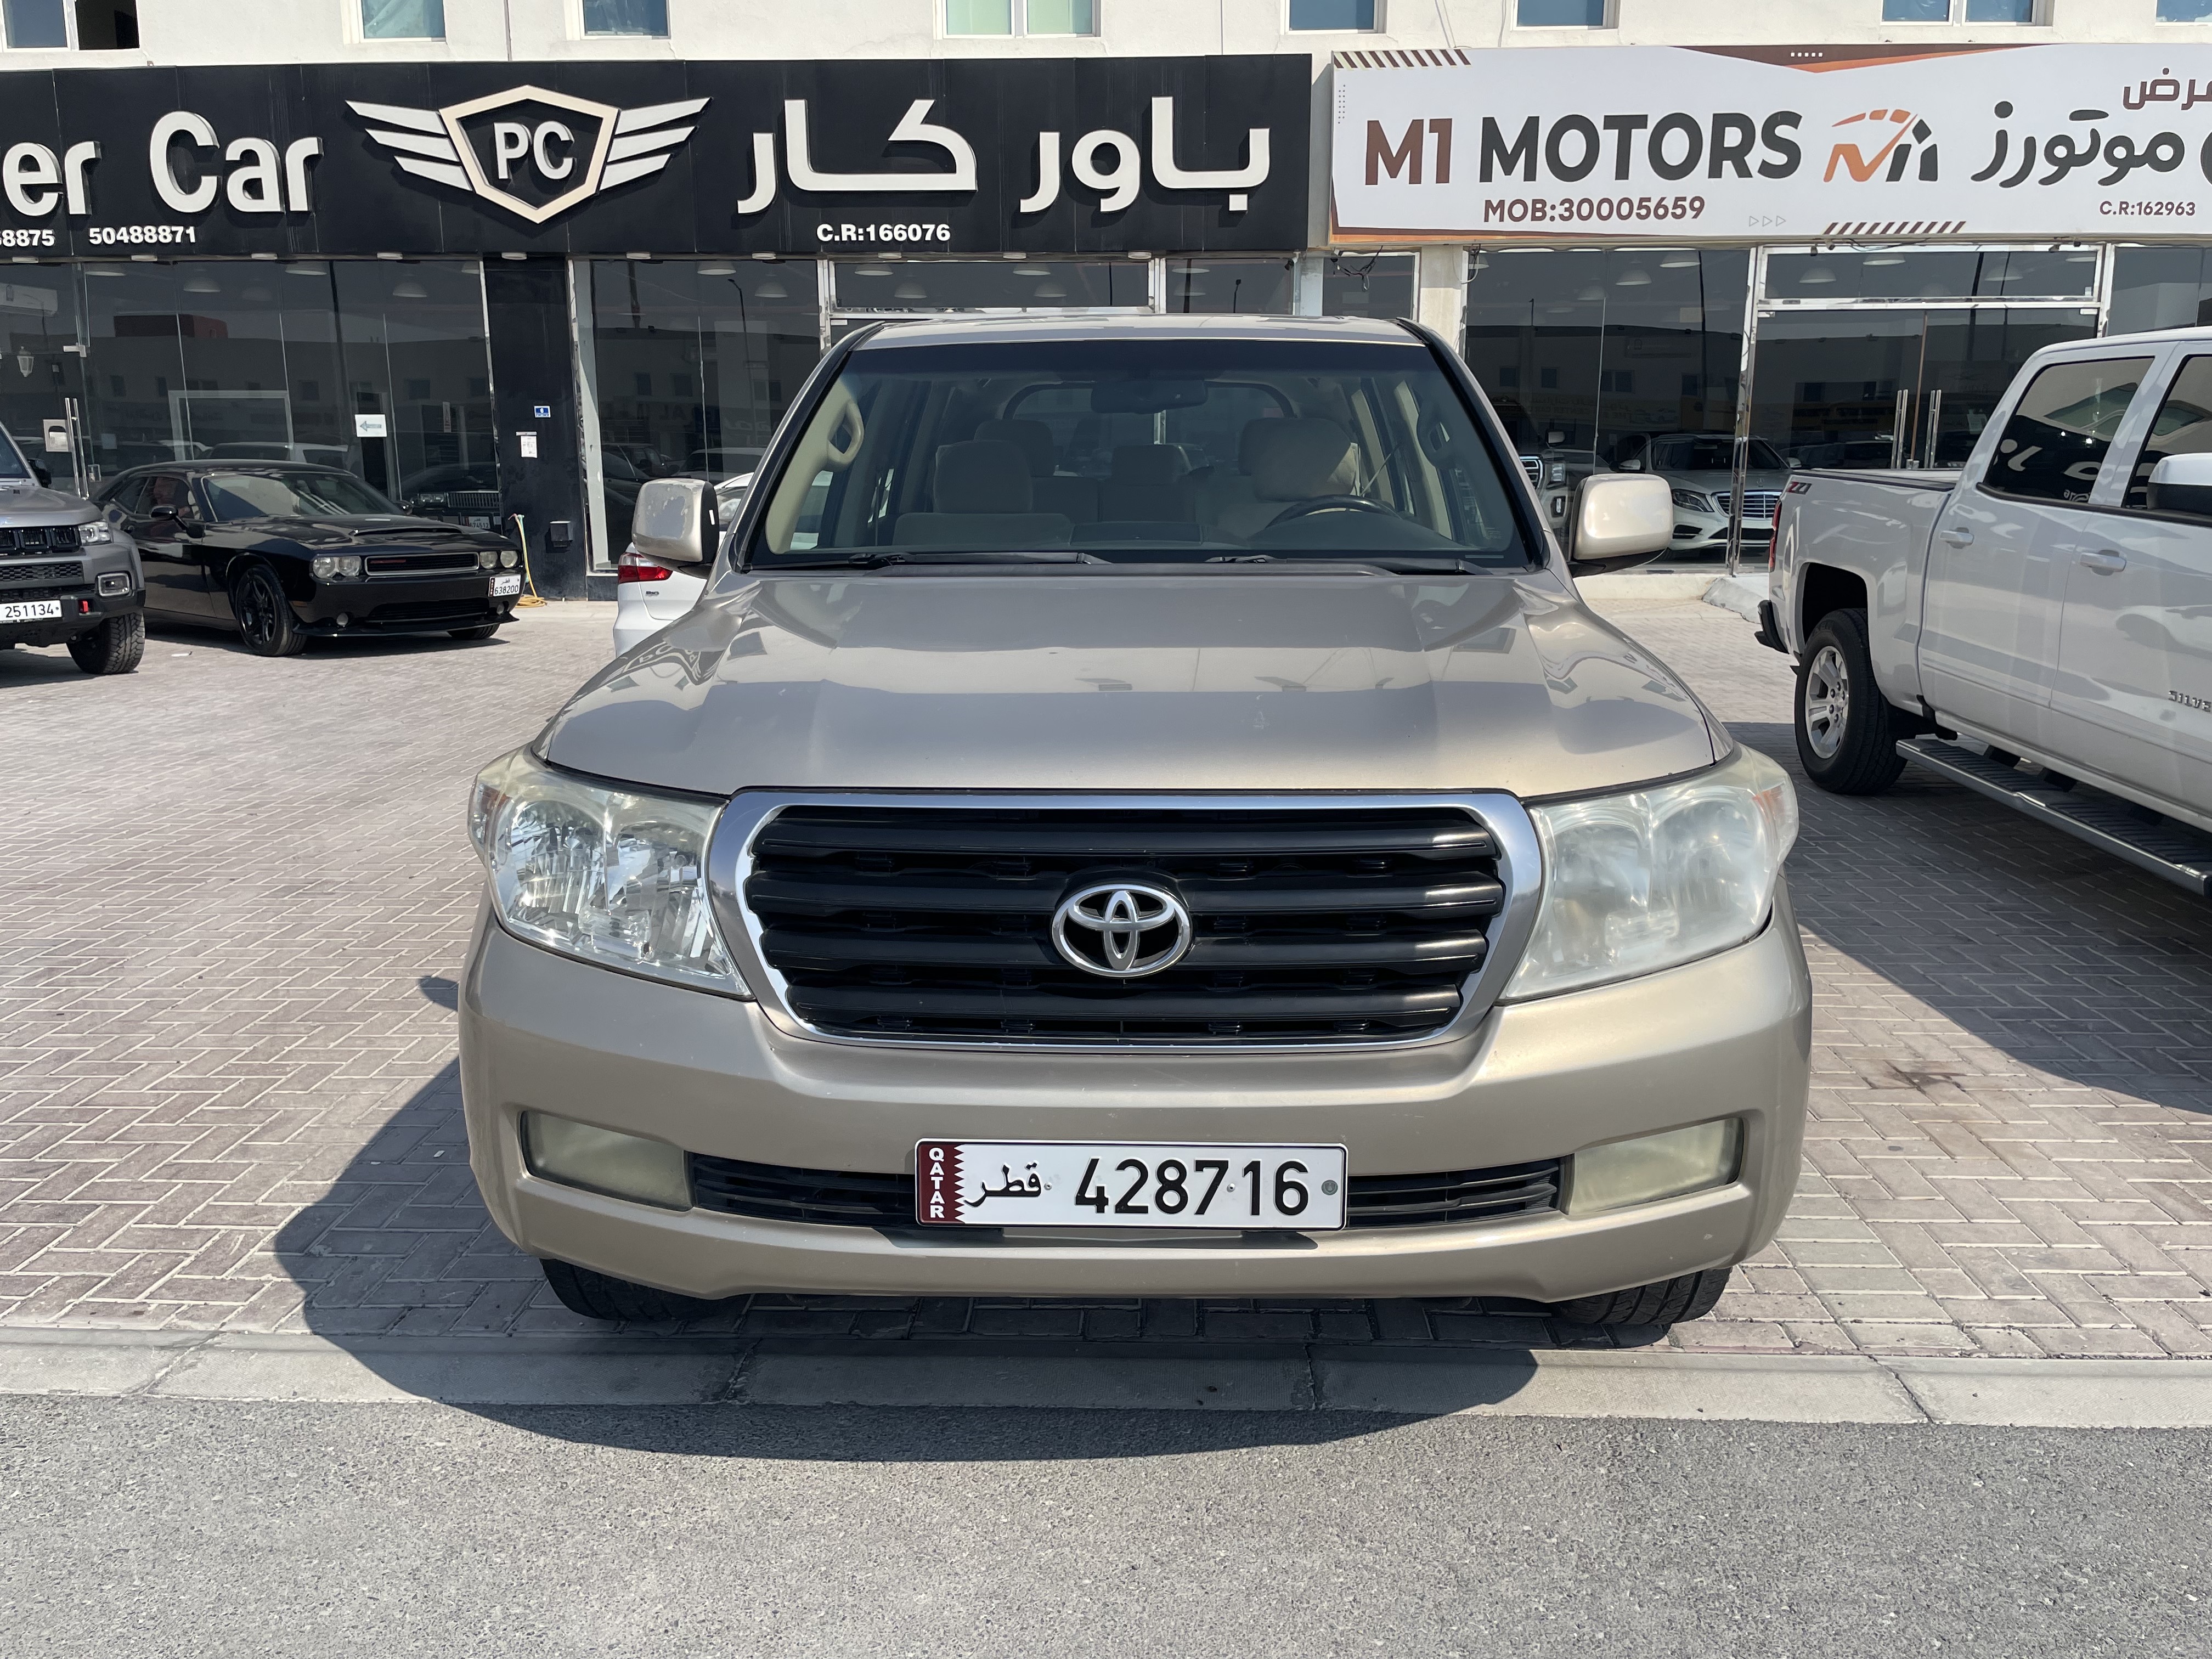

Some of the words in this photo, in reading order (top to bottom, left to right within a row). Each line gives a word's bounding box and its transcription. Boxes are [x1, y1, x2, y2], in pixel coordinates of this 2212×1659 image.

[150, 111, 323, 213] Car
[493, 121, 575, 180] PC
[737, 99, 978, 214] كار
[1019, 96, 1271, 213] باور
[1365, 118, 1453, 185] M1
[1479, 110, 1803, 183] MOTORS
[1971, 100, 2186, 188] موتورز
[0, 229, 55, 247] 8875
[89, 225, 196, 245] 50488871
[816, 224, 951, 242] C.R:166076
[1483, 196, 1706, 223] MOB:30005659
[2100, 201, 2196, 216] C.R:162963
[5, 603, 54, 618] 251134
[494, 585, 518, 595] 638200
[928, 1147, 946, 1218] QATAR
[963, 1161, 1041, 1207] قطر
[1074, 1158, 1309, 1216] 428716
